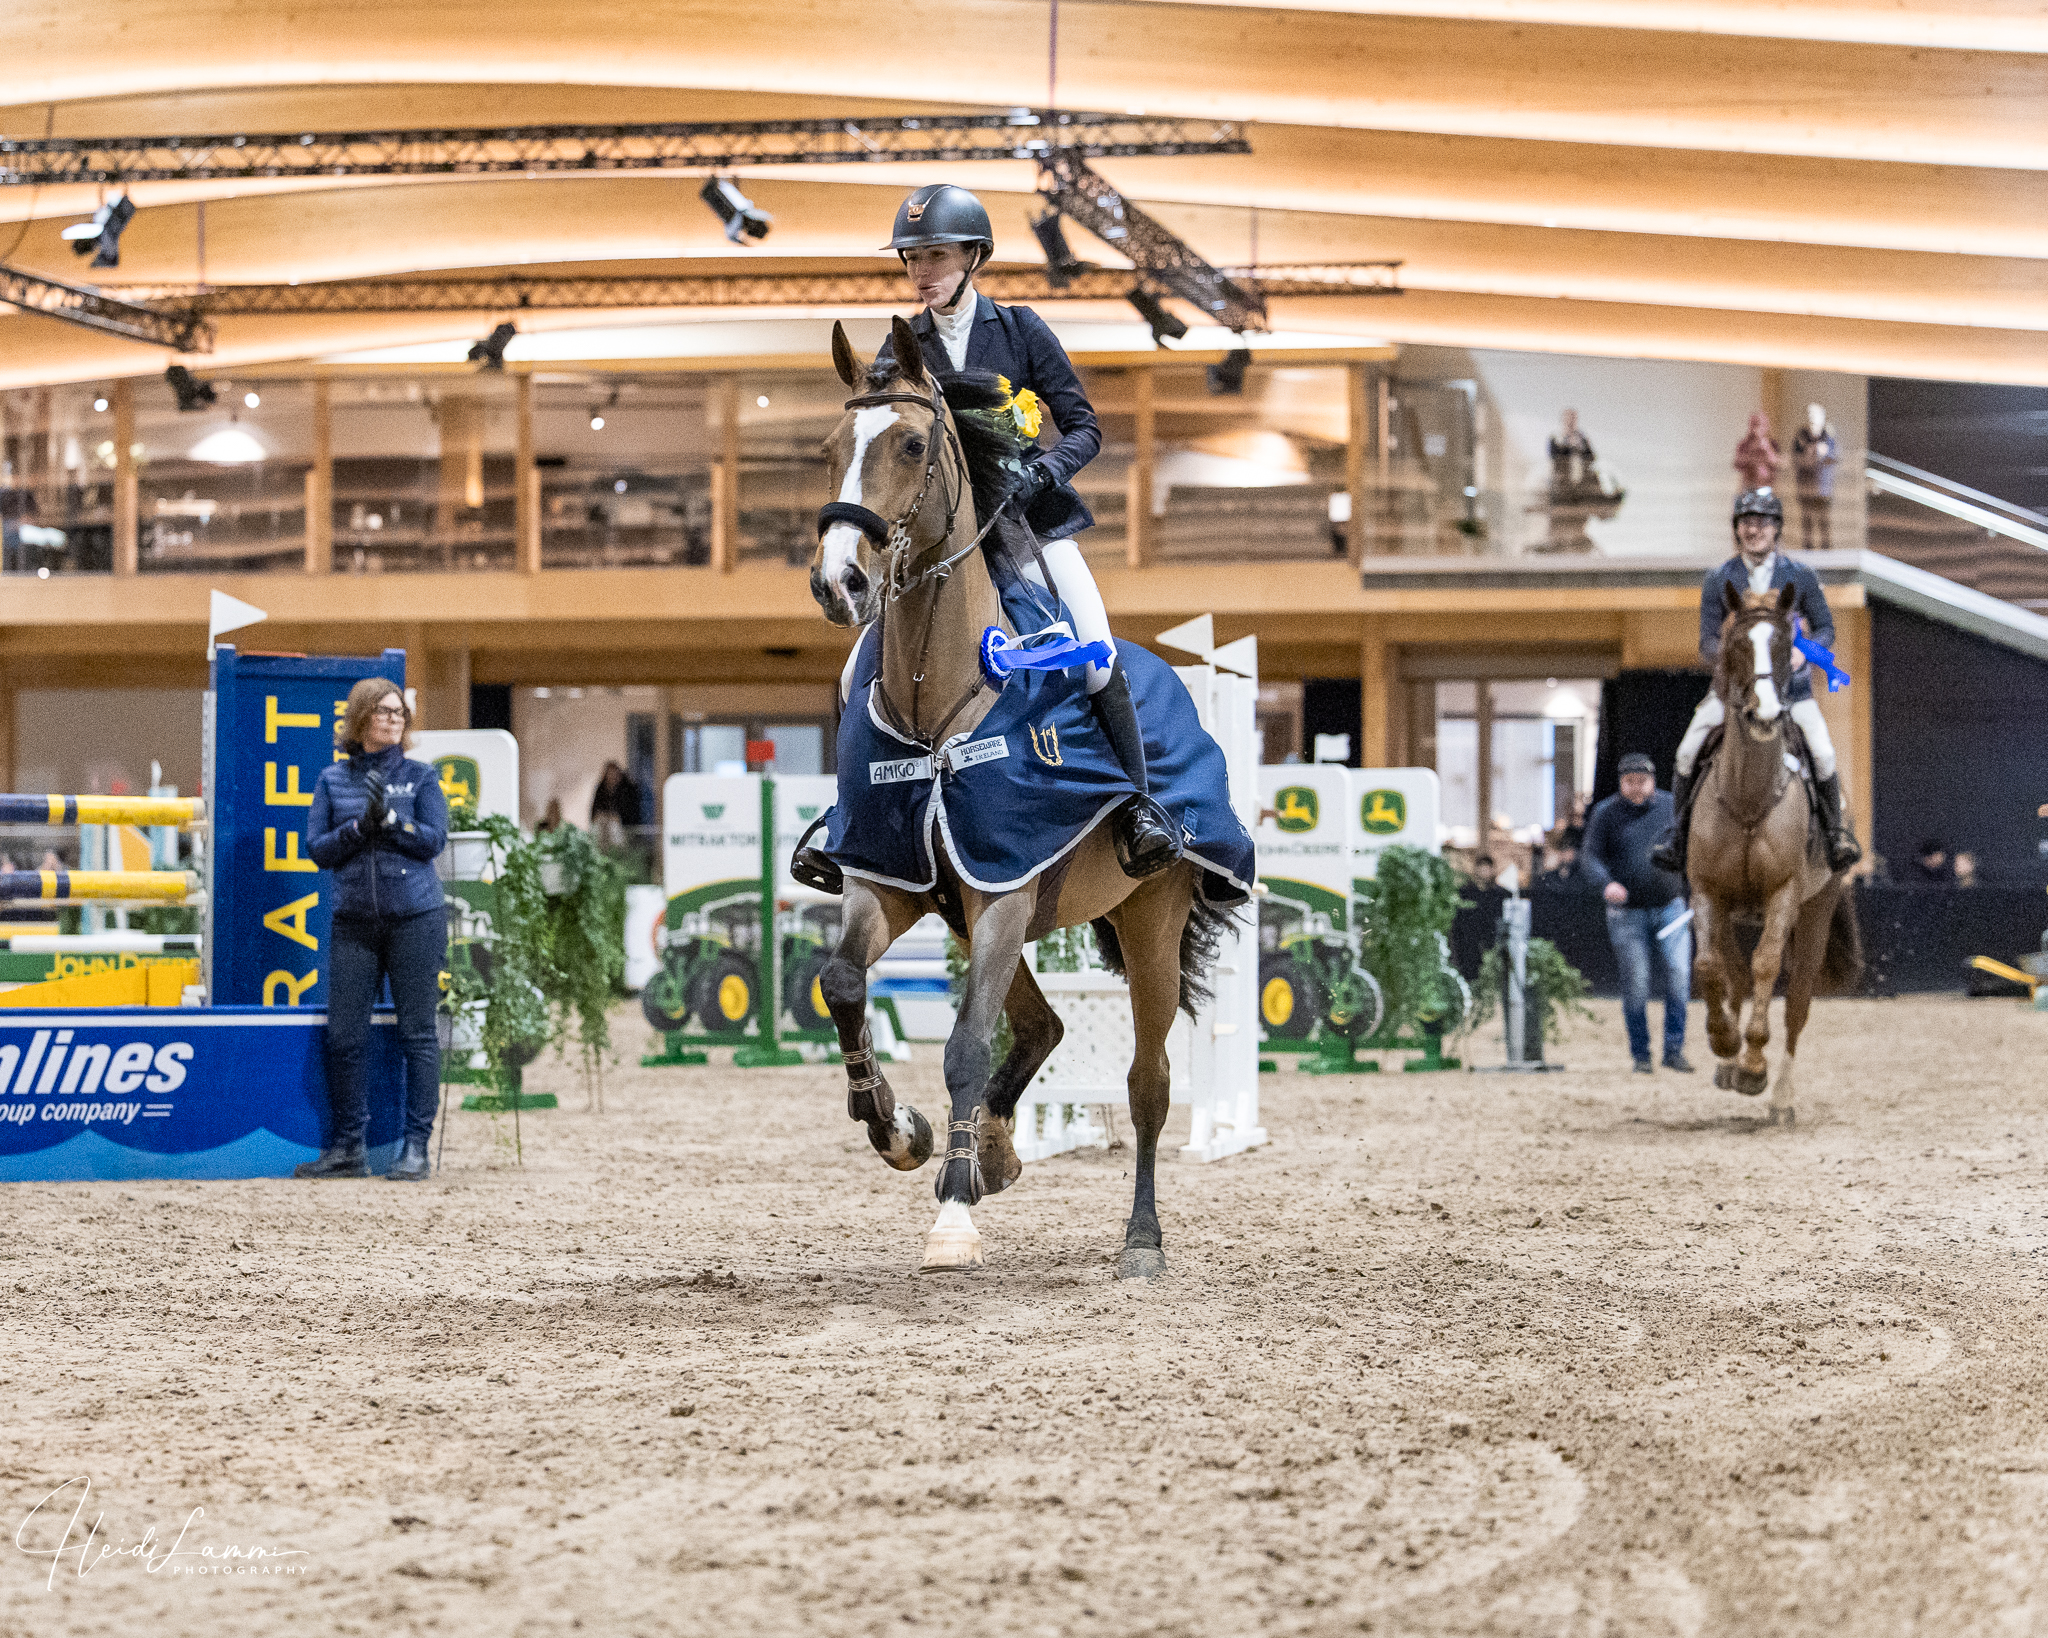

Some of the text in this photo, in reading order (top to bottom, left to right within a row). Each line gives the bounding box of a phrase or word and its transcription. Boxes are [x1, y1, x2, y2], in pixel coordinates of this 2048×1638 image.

[960, 739, 1003, 755] HORSEWARE
[974, 749, 1004, 761] IRELAND
[873, 762, 915, 781] AMIGO
[263, 694, 321, 1007] RAFFT
[41, 1102, 142, 1126] company
